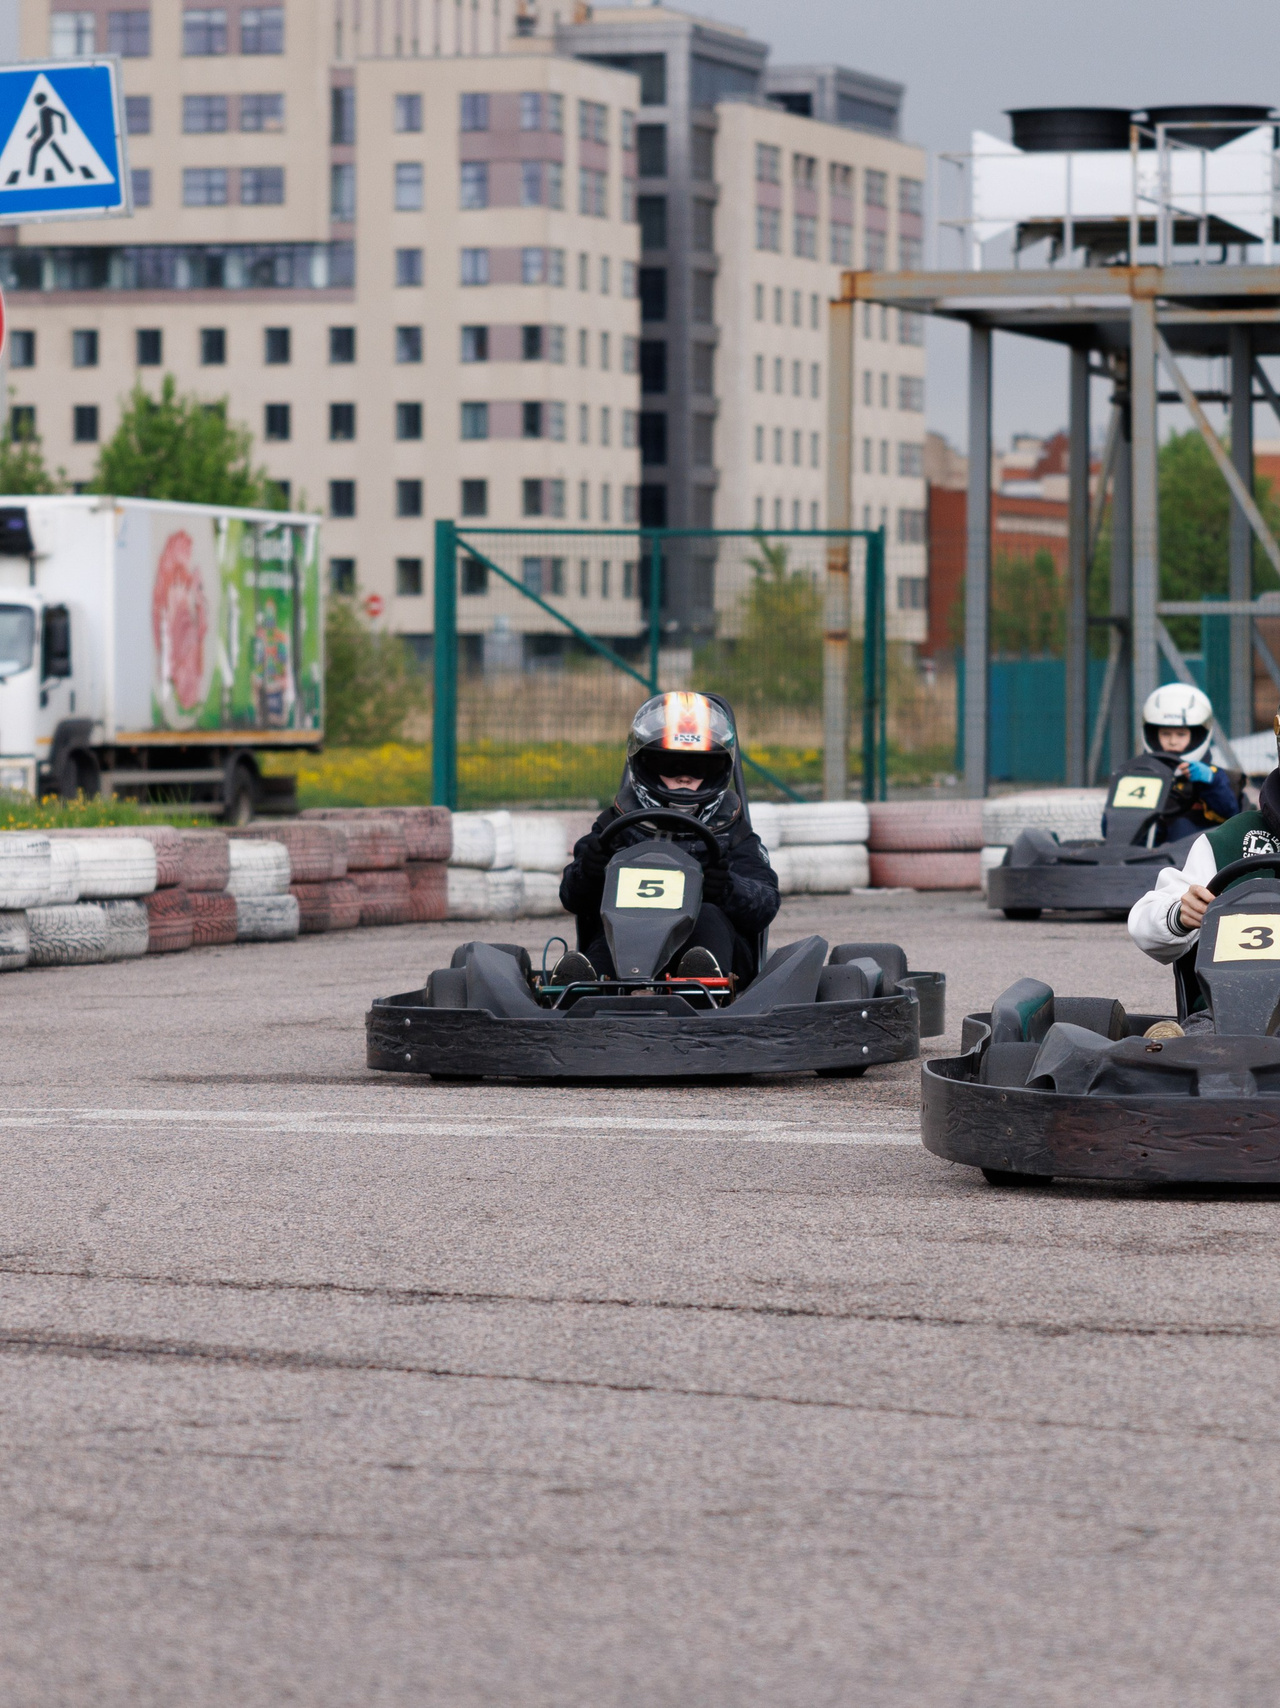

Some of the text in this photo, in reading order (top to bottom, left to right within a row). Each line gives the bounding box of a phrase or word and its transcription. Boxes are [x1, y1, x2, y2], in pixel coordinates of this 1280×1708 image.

[1128, 786, 1146, 799] 4
[1243, 830, 1271, 845] UNIVERSITY
[1248, 835, 1275, 855] LA
[636, 879, 665, 898] 5
[1238, 926, 1274, 950] 3
